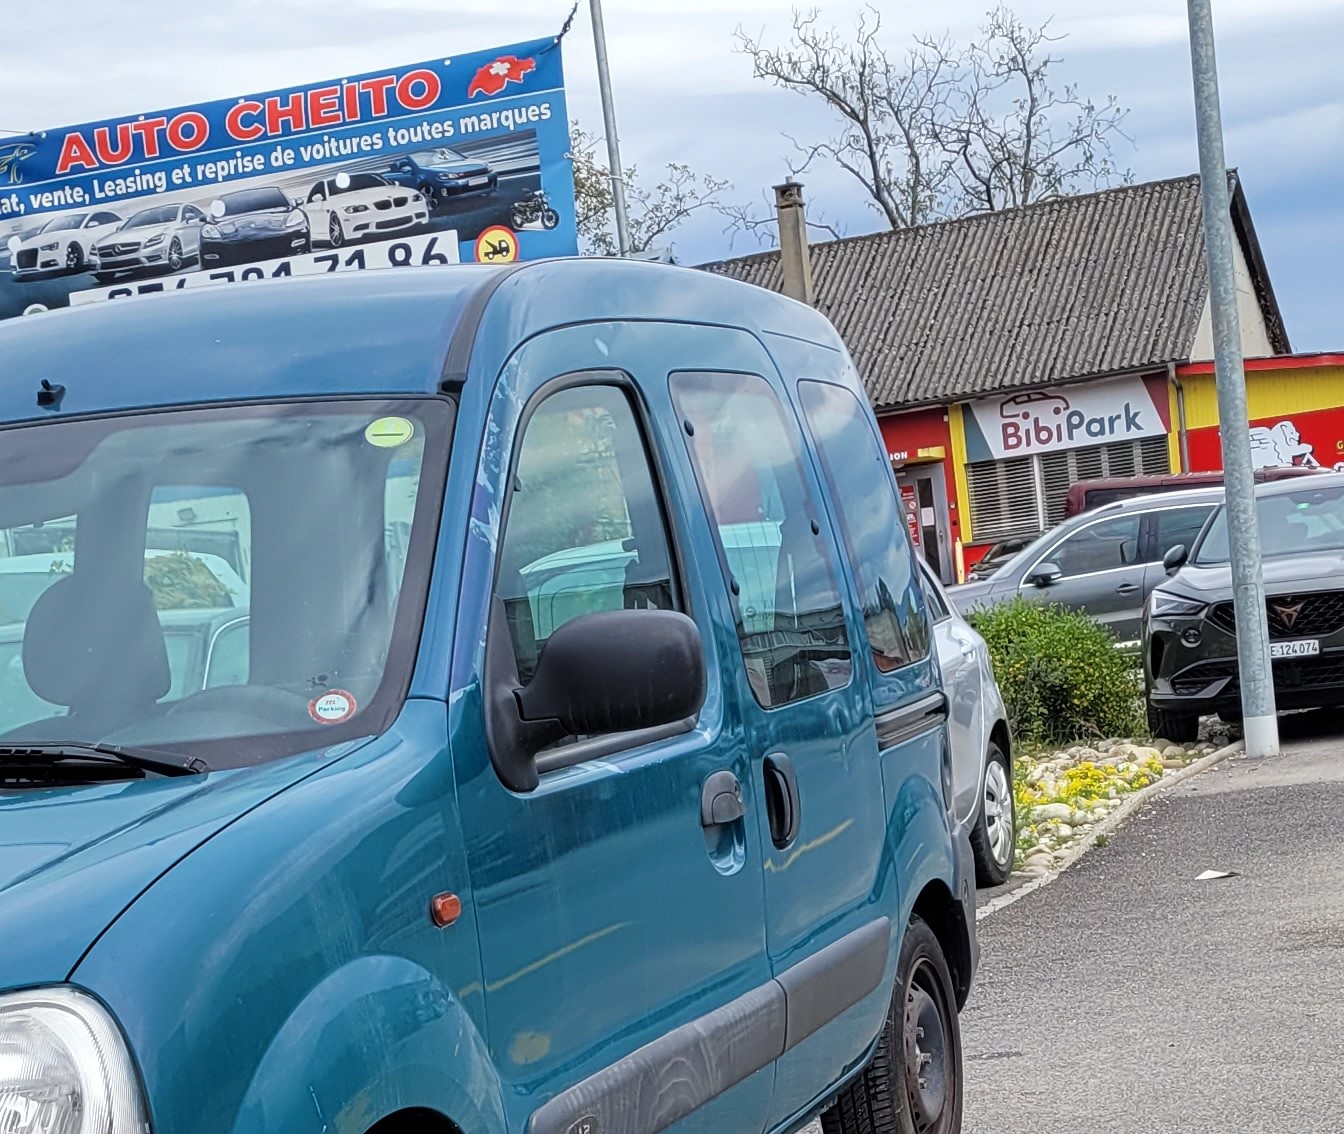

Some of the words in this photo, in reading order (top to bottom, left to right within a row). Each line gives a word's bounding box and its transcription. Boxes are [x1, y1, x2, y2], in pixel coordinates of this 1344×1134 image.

[30, 184, 90, 209] vente,
[93, 168, 167, 198] Leasing
[171, 165, 193, 183] et
[197, 149, 266, 182] reprise
[270, 144, 296, 167] de
[299, 131, 384, 160] voitures
[387, 117, 455, 147] toutes
[459, 101, 552, 137] marques
[56, 111, 209, 174] AUTO
[226, 69, 441, 141] CHEITO
[1001, 402, 1144, 451] BibiPark
